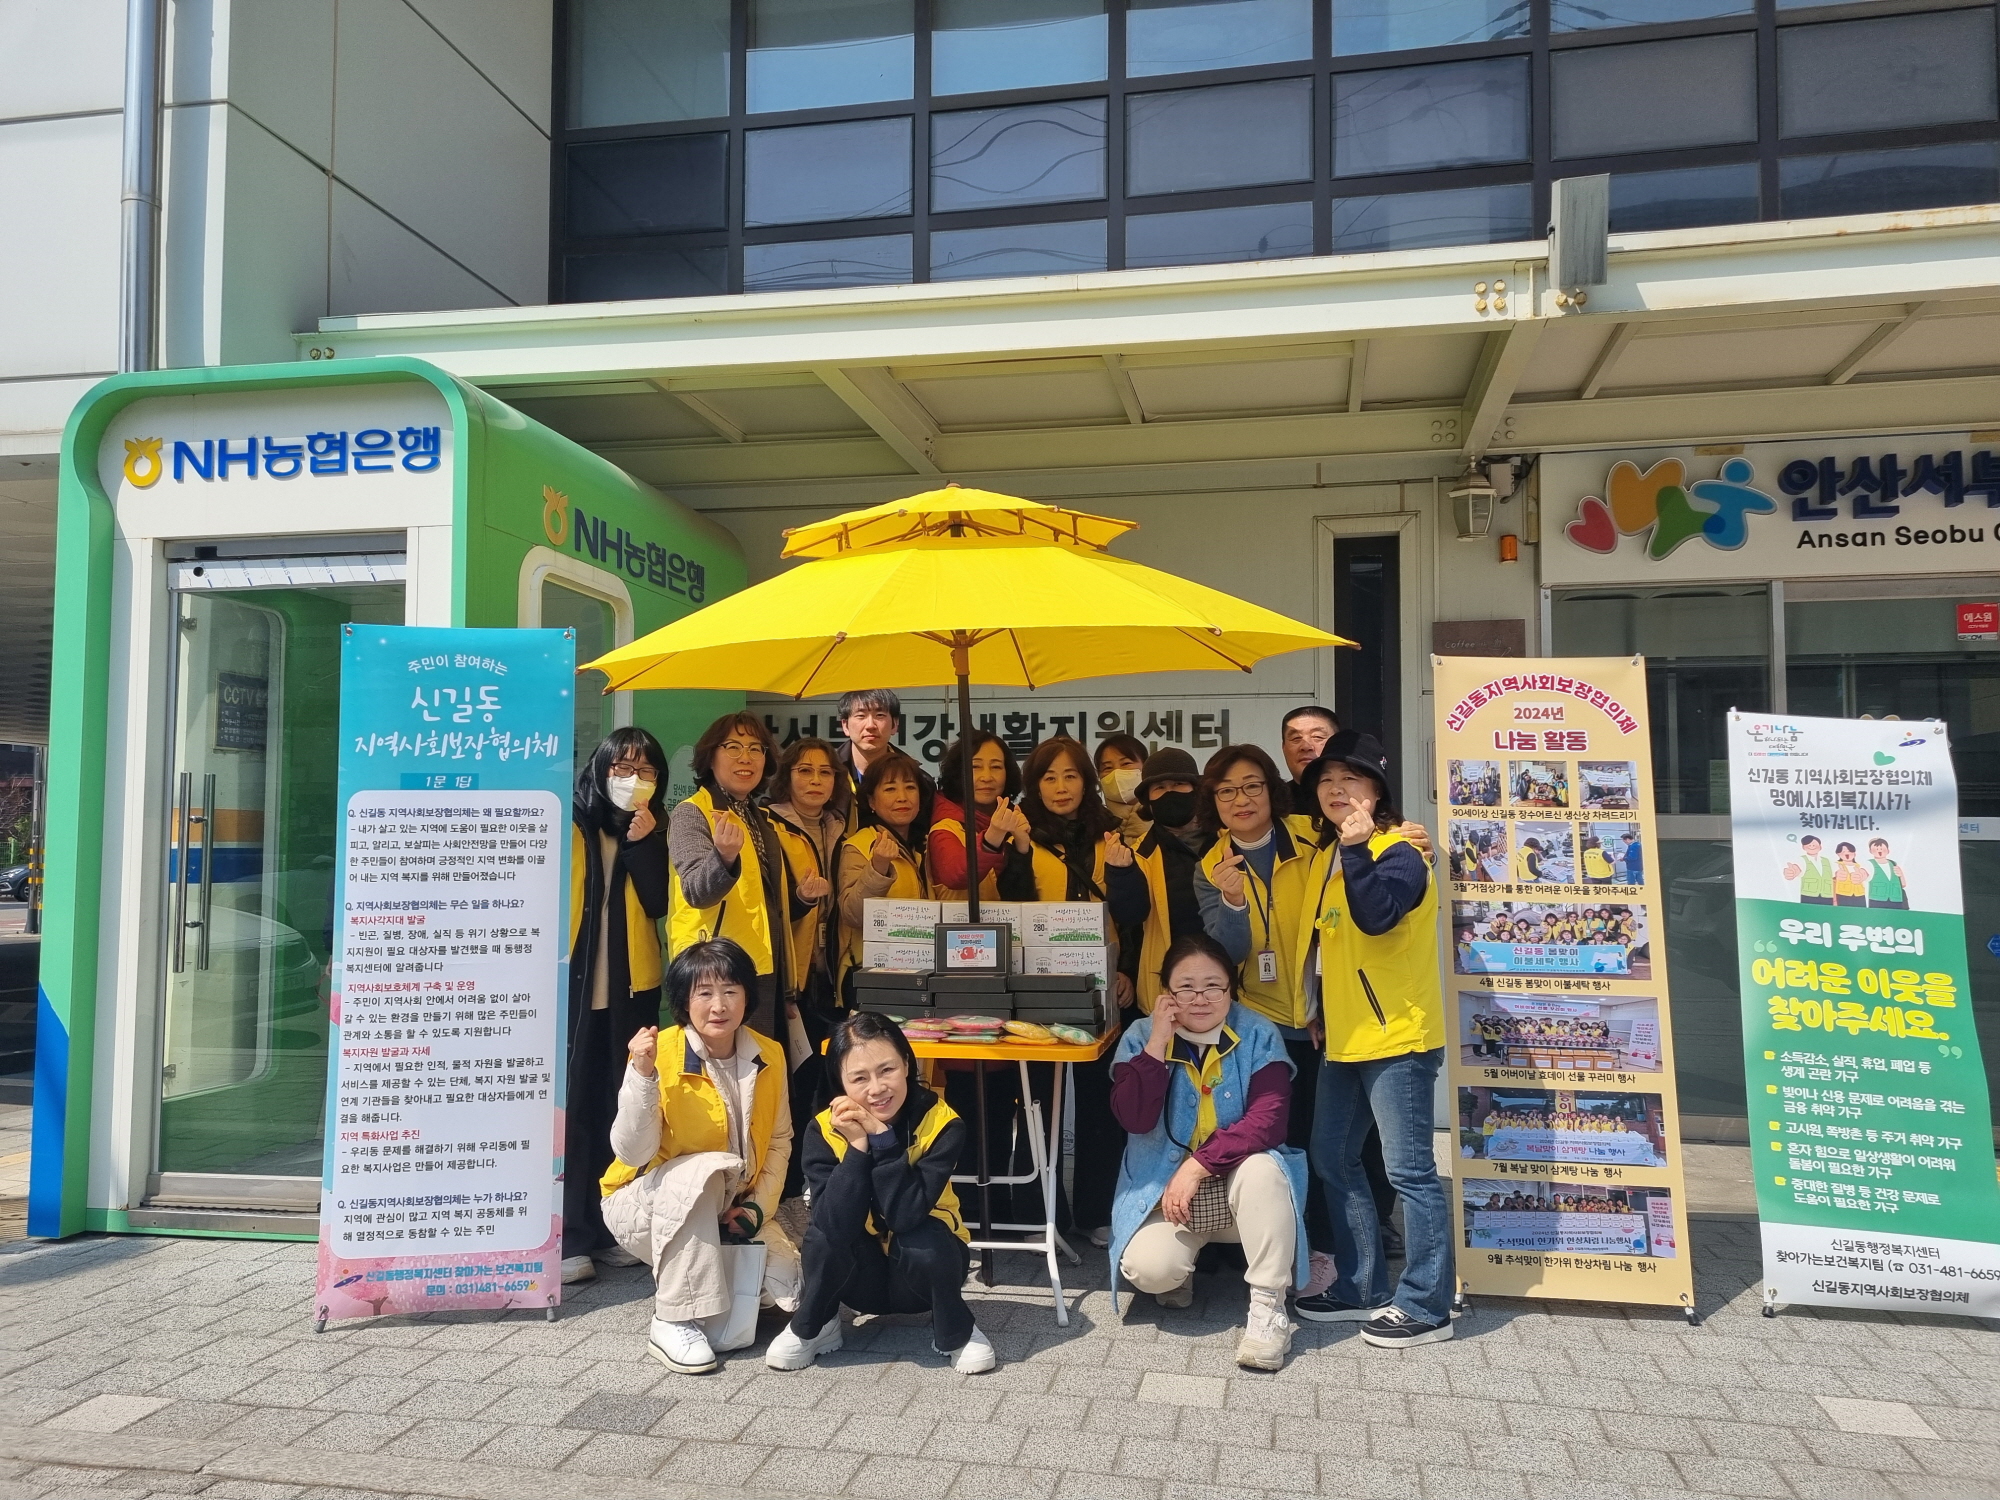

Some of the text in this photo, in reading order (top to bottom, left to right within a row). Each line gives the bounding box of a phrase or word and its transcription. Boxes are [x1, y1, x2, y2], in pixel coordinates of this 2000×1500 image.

[172, 426, 441, 481] NH농협은행
[1797, 526, 1885, 548] Ansan
[1895, 524, 1984, 545] Seobu
[573, 508, 706, 603] NH농협은행
[1964, 612, 1992, 622] 에스원
[408, 654, 508, 675] 주민이 참여하는
[411, 685, 501, 723] 신길동
[1446, 673, 1639, 735] 신길동지역사회보장협의체
[1514, 707, 1564, 720] 2024년
[355, 728, 558, 761] 지역사회보장협의체
[1494, 730, 1588, 751] 나눔 활동
[1748, 768, 1932, 786] 신길동 지역사회보장협의체
[1770, 789, 1911, 810] 명예사회복지사가
[348, 807, 544, 818] Q. 신길동 지역사회보장협의체는 왜 필요할까요?
[1453, 809, 1637, 820] 90세이상 신길동 장수어르신 생신상 차려드리기
[1800, 814, 1880, 831] 찾아갑니다.
[1515, 885, 1533, 894] 통한
[1535, 885, 1561, 894] 어려운
[1563, 885, 1590, 895] 이웃을
[346, 899, 524, 911] Q. 지역사회보장협의체는 무슨 일을 하나요?
[350, 915, 425, 926] 복지사각지대 발굴
[1779, 919, 1924, 955] 우리 주변의
[1513, 947, 1543, 956] 신길동
[1514, 956, 1555, 966] 이불세탁
[348, 981, 475, 992] 지역사회보호체계 구축 및 운영
[1480, 978, 1611, 990] 4월 신길동 봄맞이 이불세탁 행사
[1752, 958, 1957, 1007] 어려운 이웃을
[1768, 996, 1949, 1040] 찾아주세요.
[342, 1046, 430, 1058] 복지자원 발굴과 자세
[1780, 1051, 1932, 1074] 소득감소, 실직, 휴업, 폐업 등
[1484, 1069, 1635, 1083] 5월 어버이날 효데이 선물 꾸러미 행사
[1780, 1066, 1859, 1083] 생계 곤란 가구
[1782, 1086, 1966, 1114] 빚이나 신용 문제로 어려움을 겪는
[1783, 1100, 1862, 1119] 금융 취약 가구
[341, 1130, 420, 1141] 지역 특화사업 추진
[1786, 1121, 1962, 1150] 고시원, 쪽방촌 등 주거 취약 가구
[1787, 1142, 1956, 1171] 혼자 힘으로 일상생활이 어려워
[1493, 1163, 1622, 1178] 7월 복날 맞이 삼계탕 나눔 행사
[1789, 1156, 1892, 1179] 돌봄이 필요한 가구
[338, 1192, 527, 1209] Q. 신길동지역사회보장협의체는 누가 하나요?
[1792, 1177, 1941, 1206] 중대한 질병 등 건강 문제로
[1794, 1192, 1899, 1214] 도움이 필요한 가구
[1831, 1238, 1940, 1260] 신길동행정복지센터
[366, 1267, 452, 1282] 신길동행정복지센터
[496, 1262, 542, 1275] 보건복지팀
[1488, 1254, 1657, 1273] 9월 추석맞이 한가위 한상차림 나눔 행사
[1776, 1250, 2000, 1281] 찾아가는보건복지팀 031-481-6659
[456, 1280, 529, 1294] 031)481-6659
[1812, 1278, 1970, 1304] 신길동지역사회보장협의체
